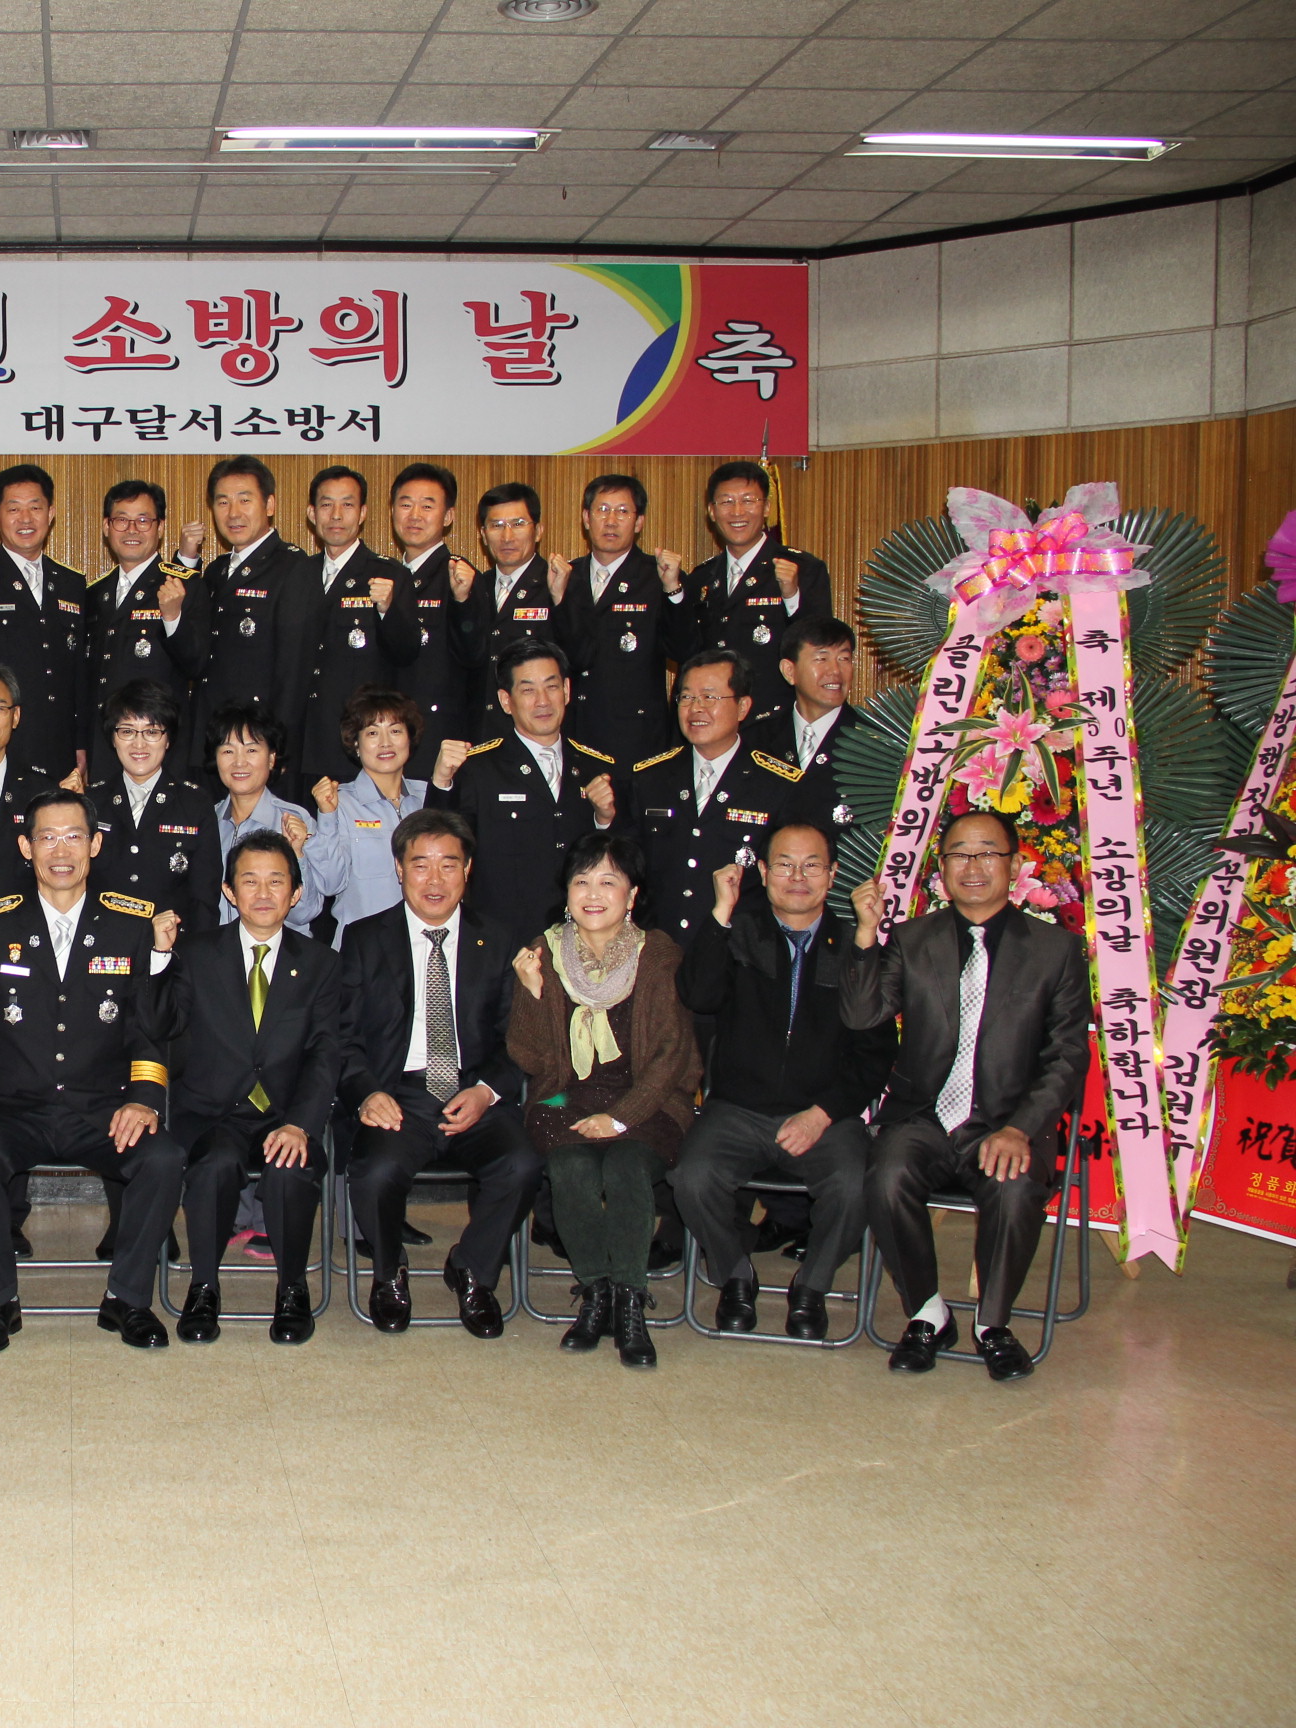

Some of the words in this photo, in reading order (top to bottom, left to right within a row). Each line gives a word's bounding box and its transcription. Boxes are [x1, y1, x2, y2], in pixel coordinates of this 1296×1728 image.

[64, 289, 408, 388] 소방의
[462, 290, 578, 386] 날
[695, 320, 797, 401] 축
[21, 403, 382, 443] 대구달서소방서
[1075, 629, 1119, 654] 축
[1101, 987, 1160, 1140] 축하합니다
